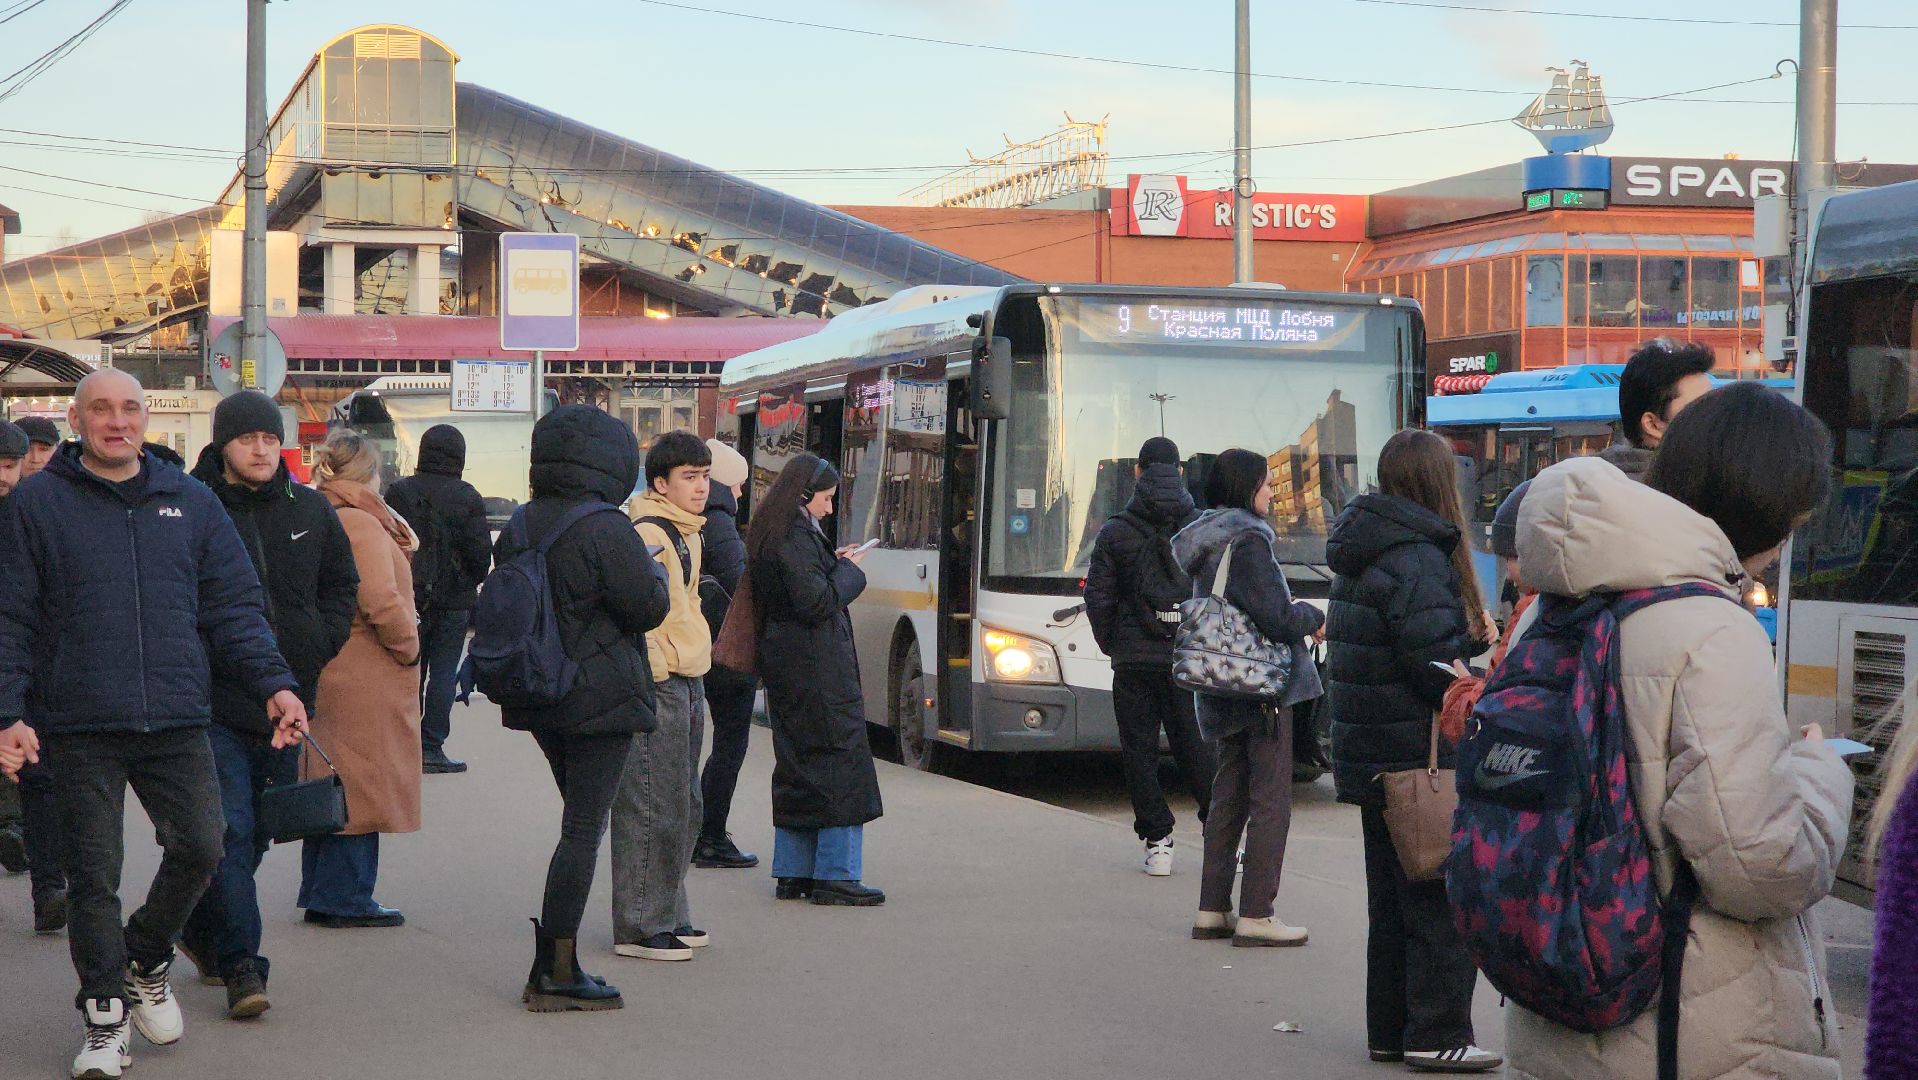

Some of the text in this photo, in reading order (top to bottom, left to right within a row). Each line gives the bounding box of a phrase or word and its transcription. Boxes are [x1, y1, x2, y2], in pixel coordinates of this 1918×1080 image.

[1626, 164, 1786, 198] SPAR
[1215, 202, 1336, 229] RSTIC'S
[1118, 305, 1131, 333] 9
[1148, 304, 1335, 328] Станция МЦД Лобня
[1164, 321, 1319, 342] Красная Поляна
[1450, 355, 1486, 373] SPAR
[159, 505, 182, 517] FILA
[1484, 742, 1543, 775] NIKE
